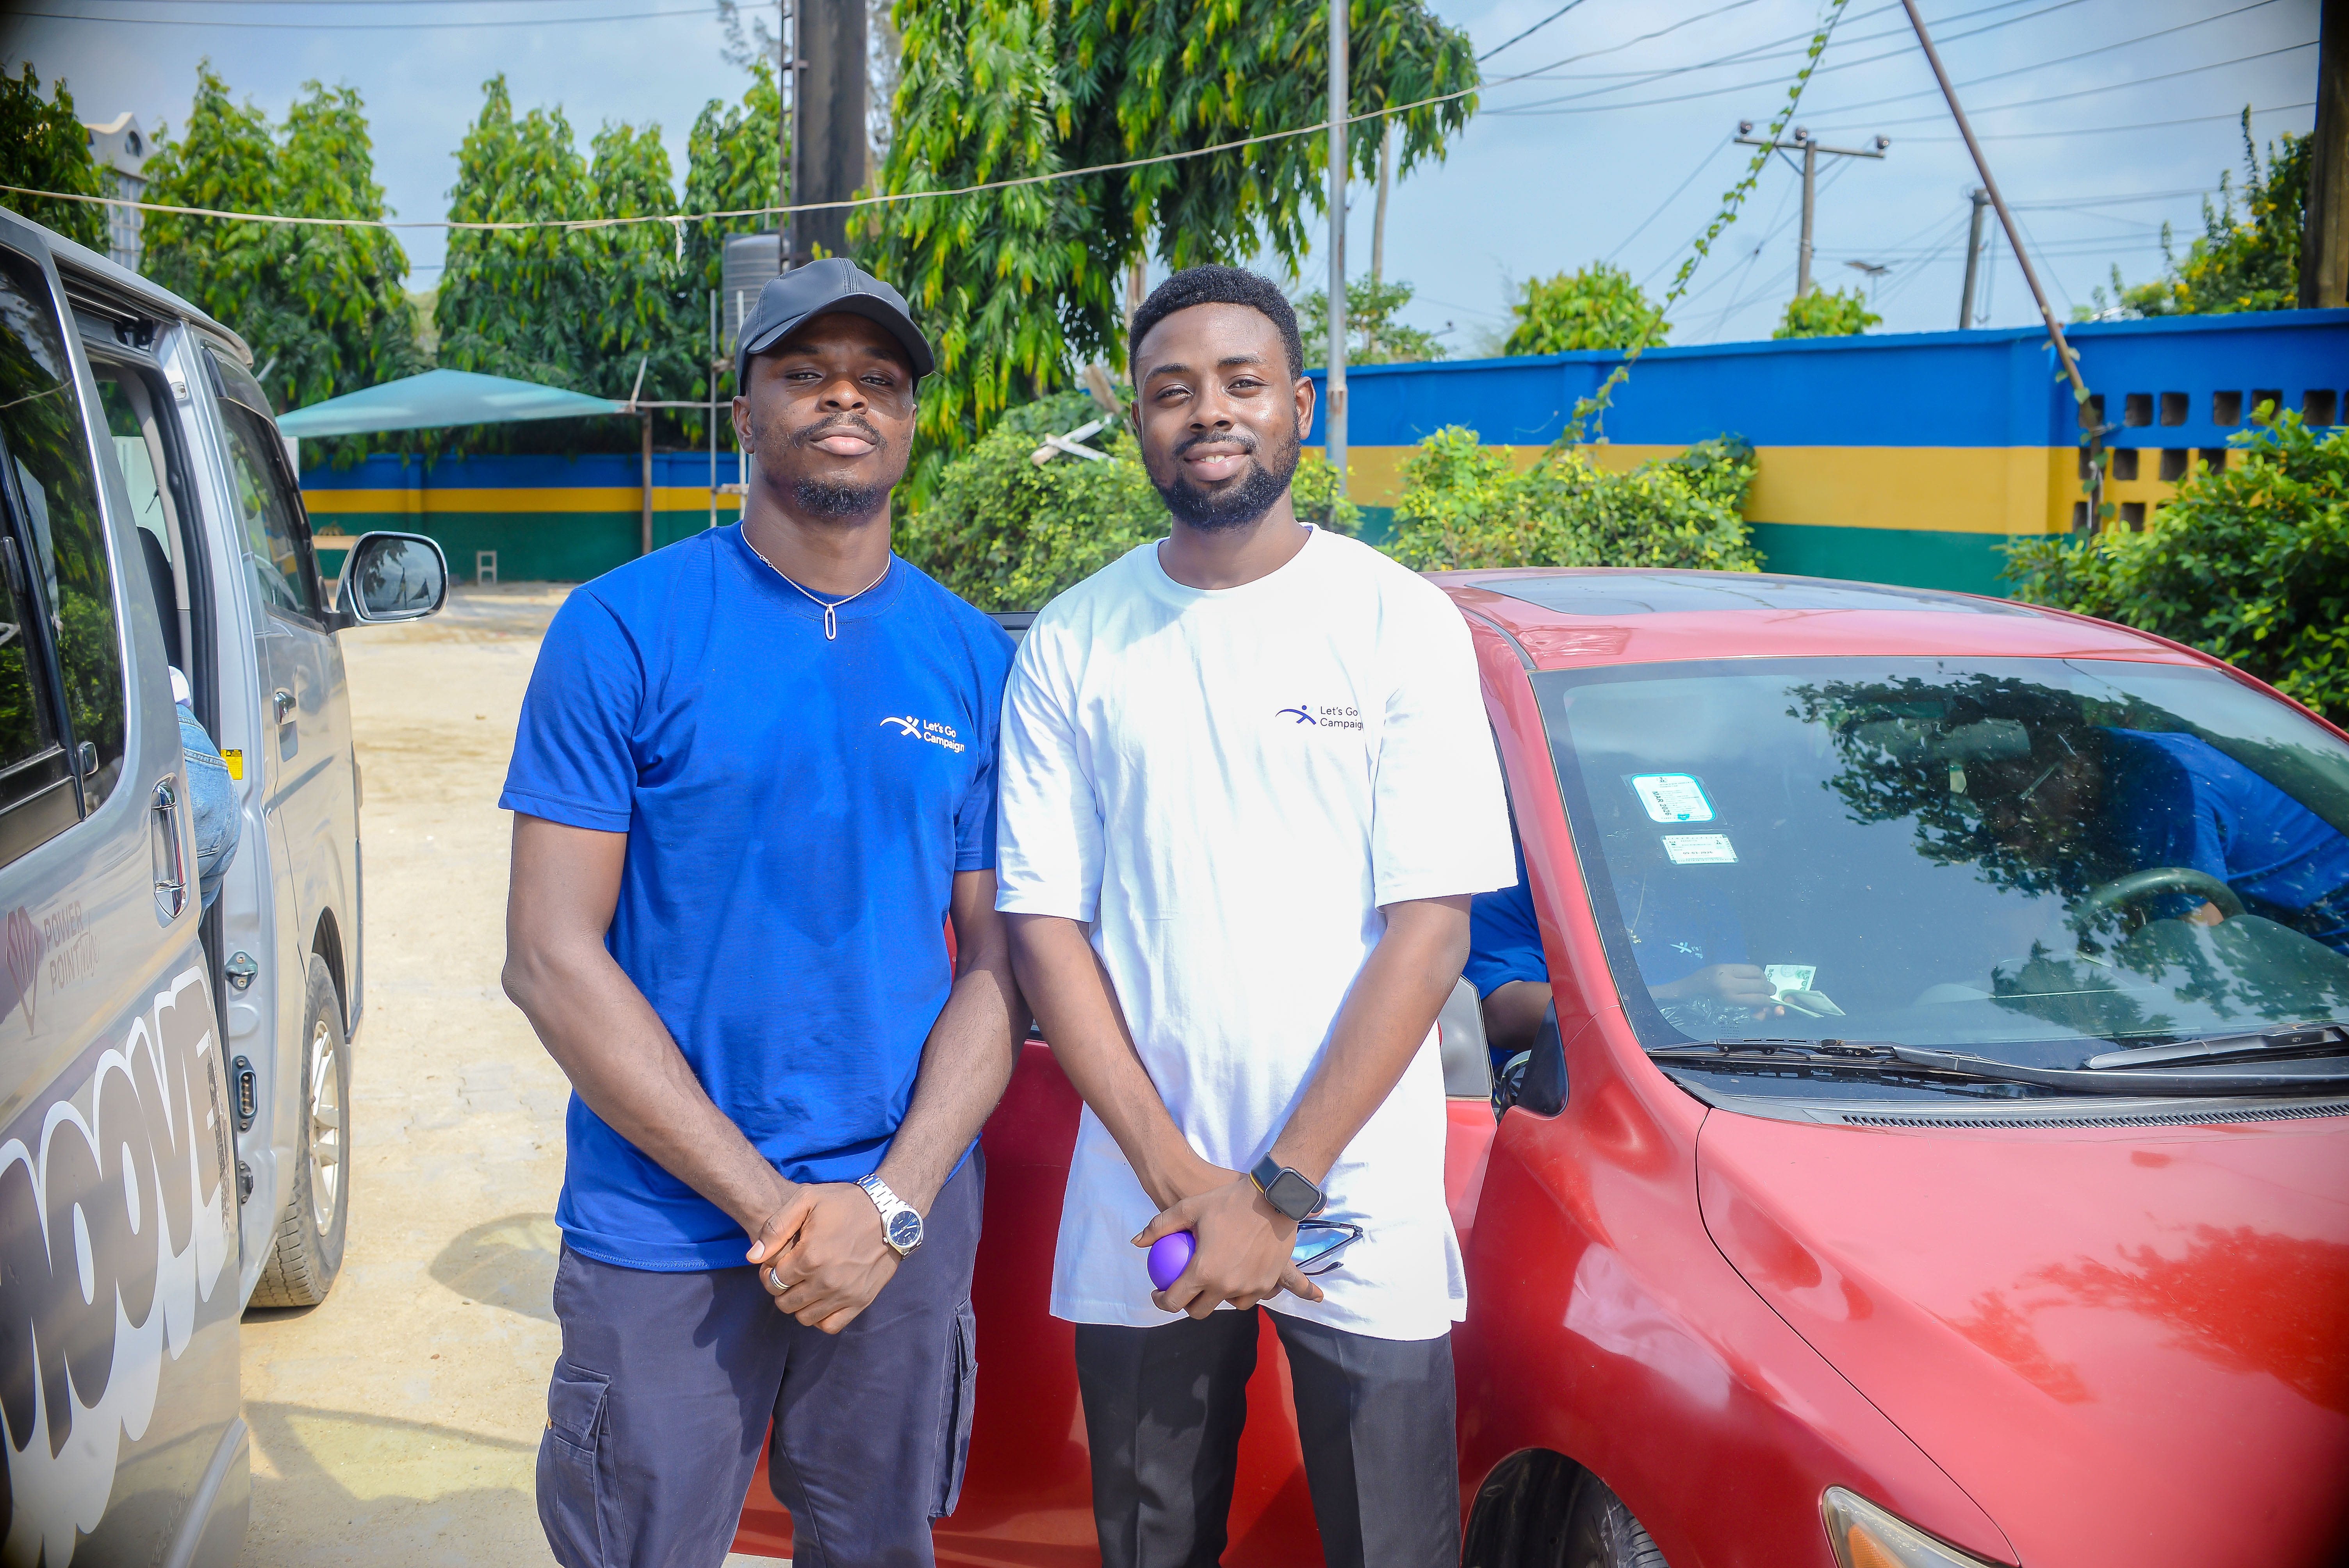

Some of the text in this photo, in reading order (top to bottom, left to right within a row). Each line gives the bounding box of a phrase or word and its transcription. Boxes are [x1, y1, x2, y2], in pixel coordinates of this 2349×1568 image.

[1321, 706, 1358, 716] Let's Go
[923, 719, 956, 738] Let's Go
[923, 731, 965, 753] Campaign
[1652, 791, 1672, 815] MAR 2026
[44, 900, 84, 953] POWER
[50, 942, 80, 995] POINT
